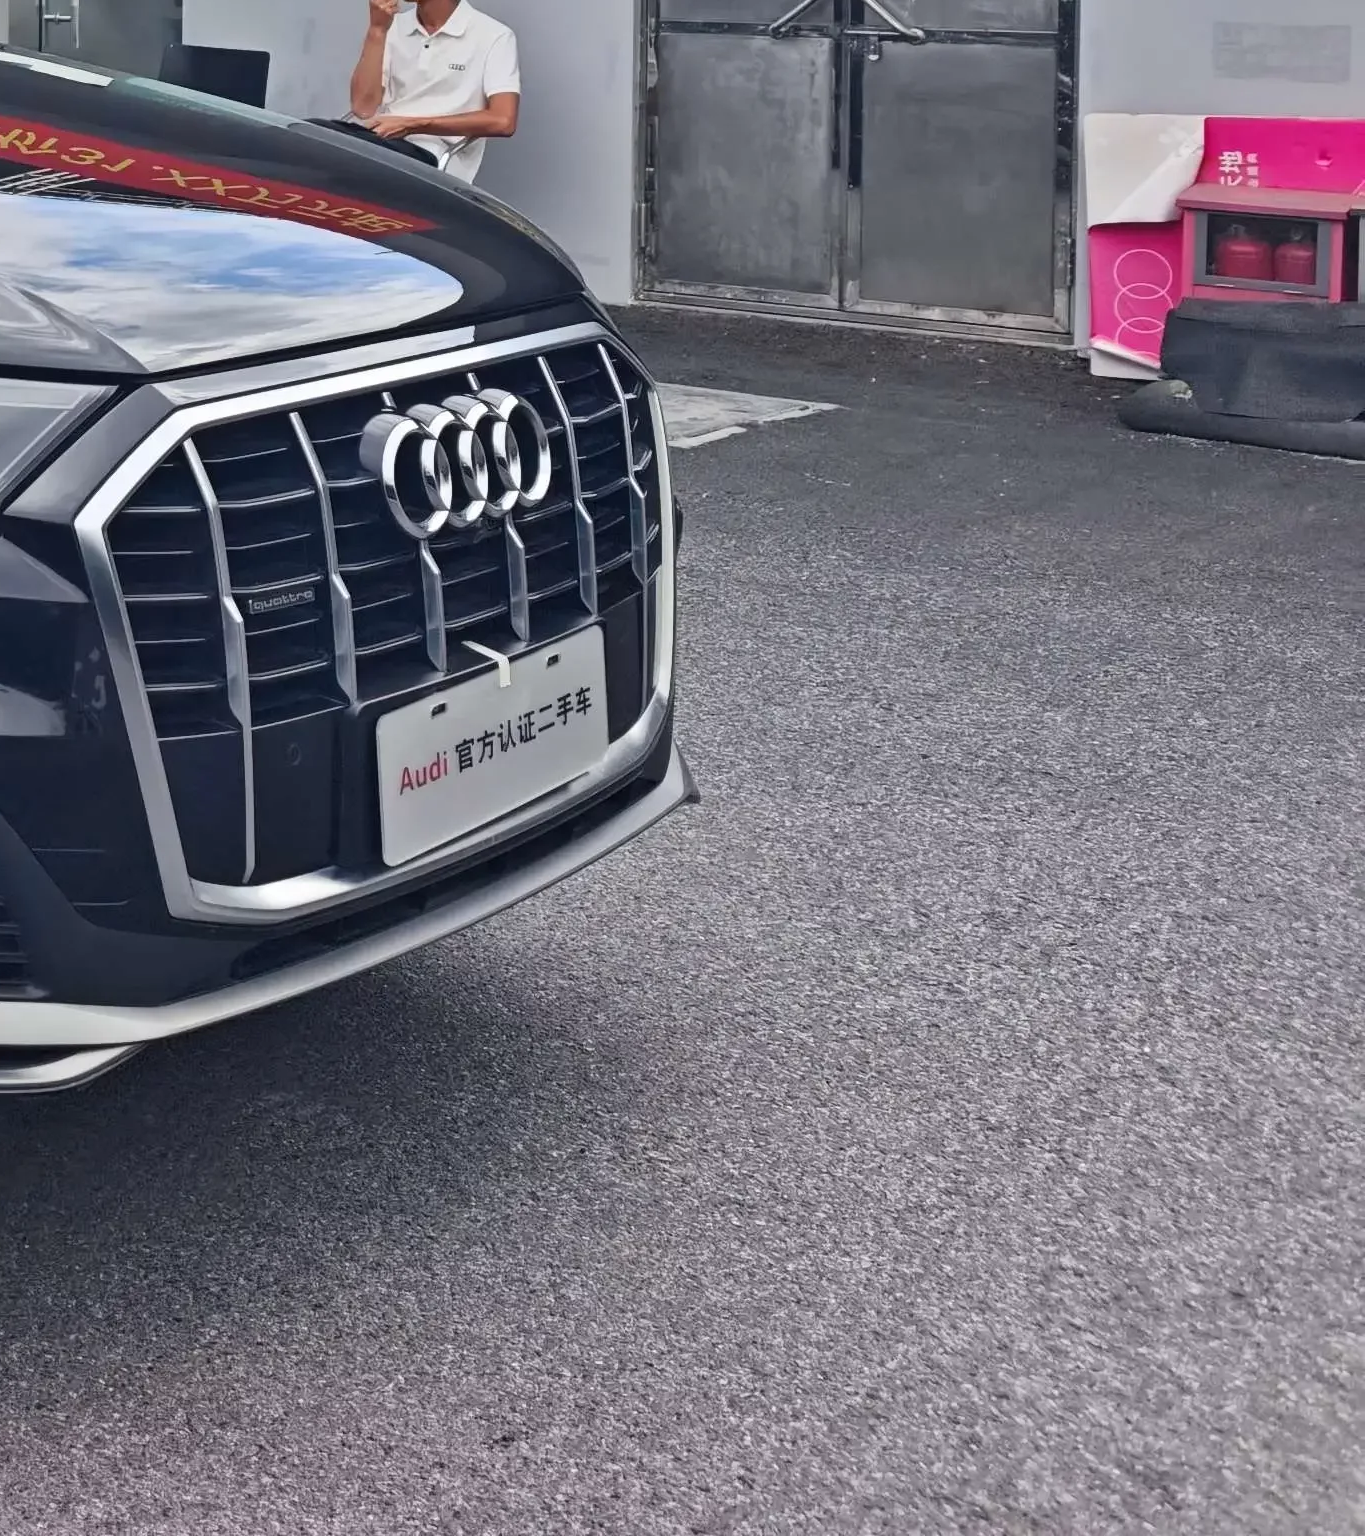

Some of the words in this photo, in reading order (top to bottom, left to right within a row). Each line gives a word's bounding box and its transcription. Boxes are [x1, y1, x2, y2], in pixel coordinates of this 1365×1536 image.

[253, 590, 313, 613] quattro
[400, 751, 448, 795] Audi
[455, 687, 592, 773] 官方认证二手车
